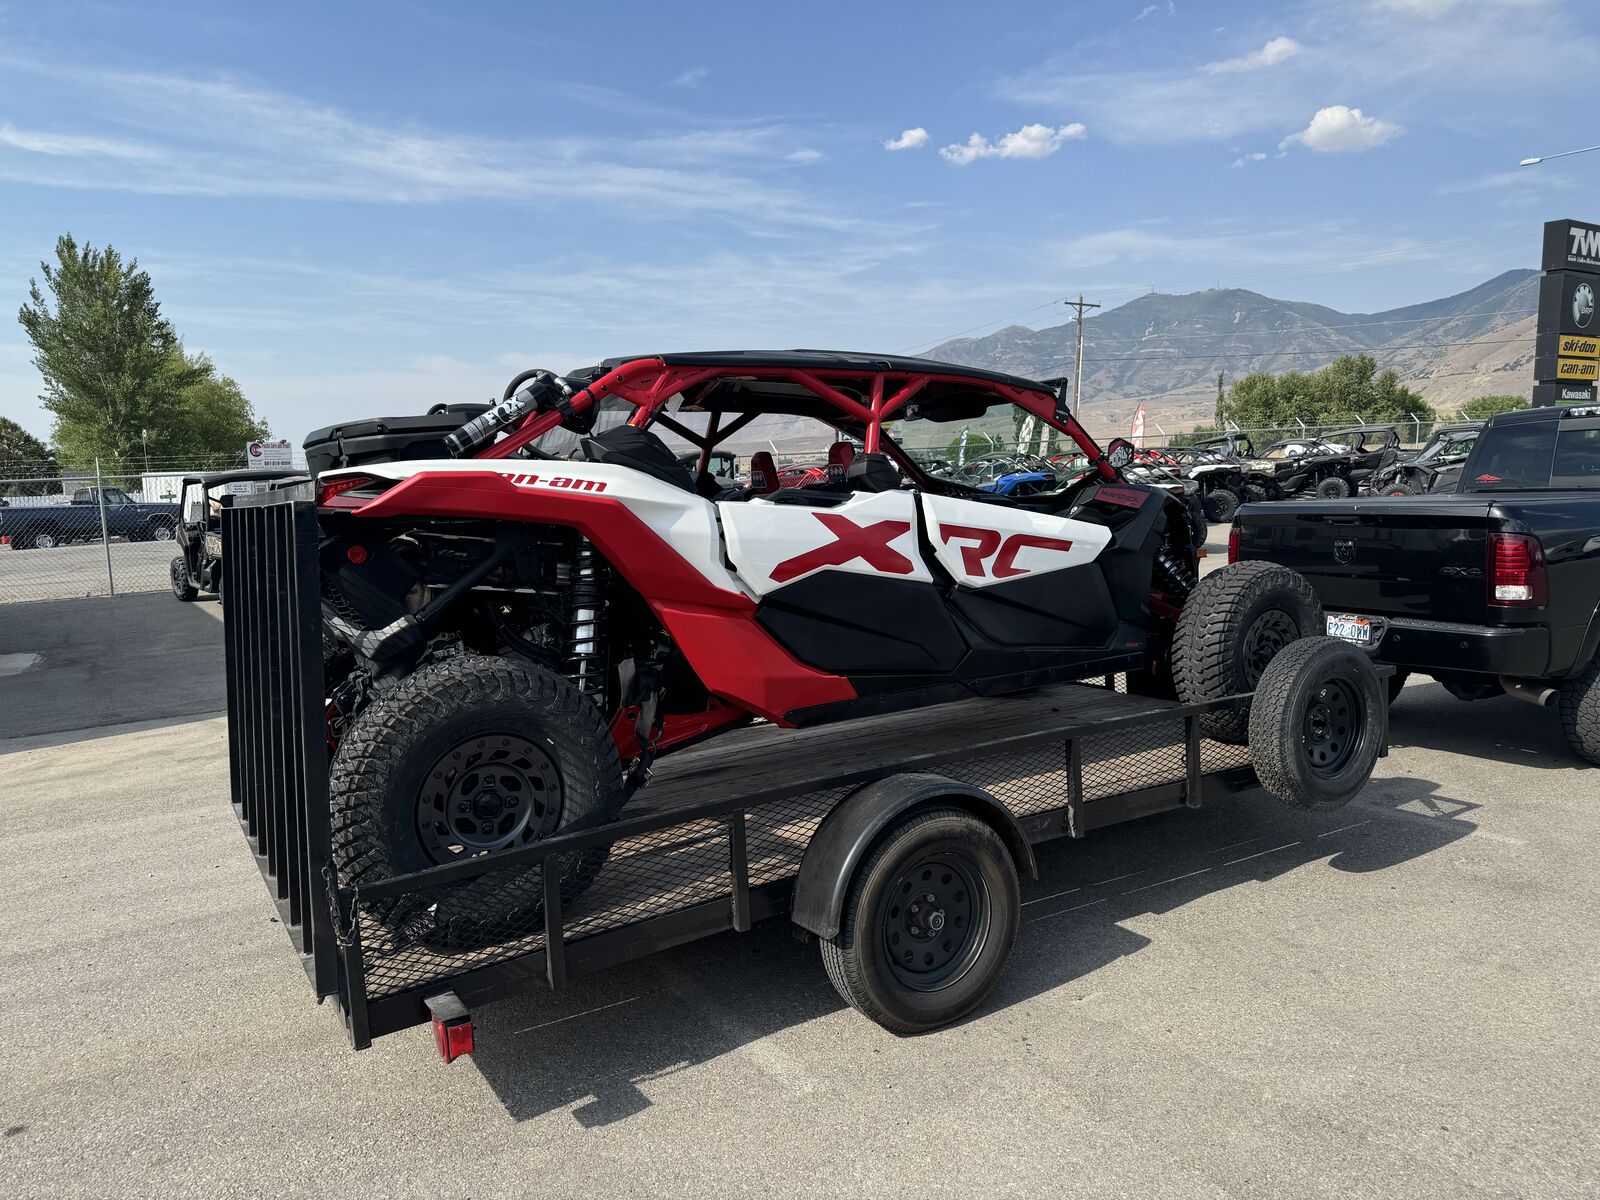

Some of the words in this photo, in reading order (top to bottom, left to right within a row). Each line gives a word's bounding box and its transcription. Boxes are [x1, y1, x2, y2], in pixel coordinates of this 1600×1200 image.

[1563, 340, 1596, 353] ski-doo
[1561, 363, 1595, 375] can-am
[1562, 388, 1591, 400] Kawasaki
[481, 394, 526, 427] FOX
